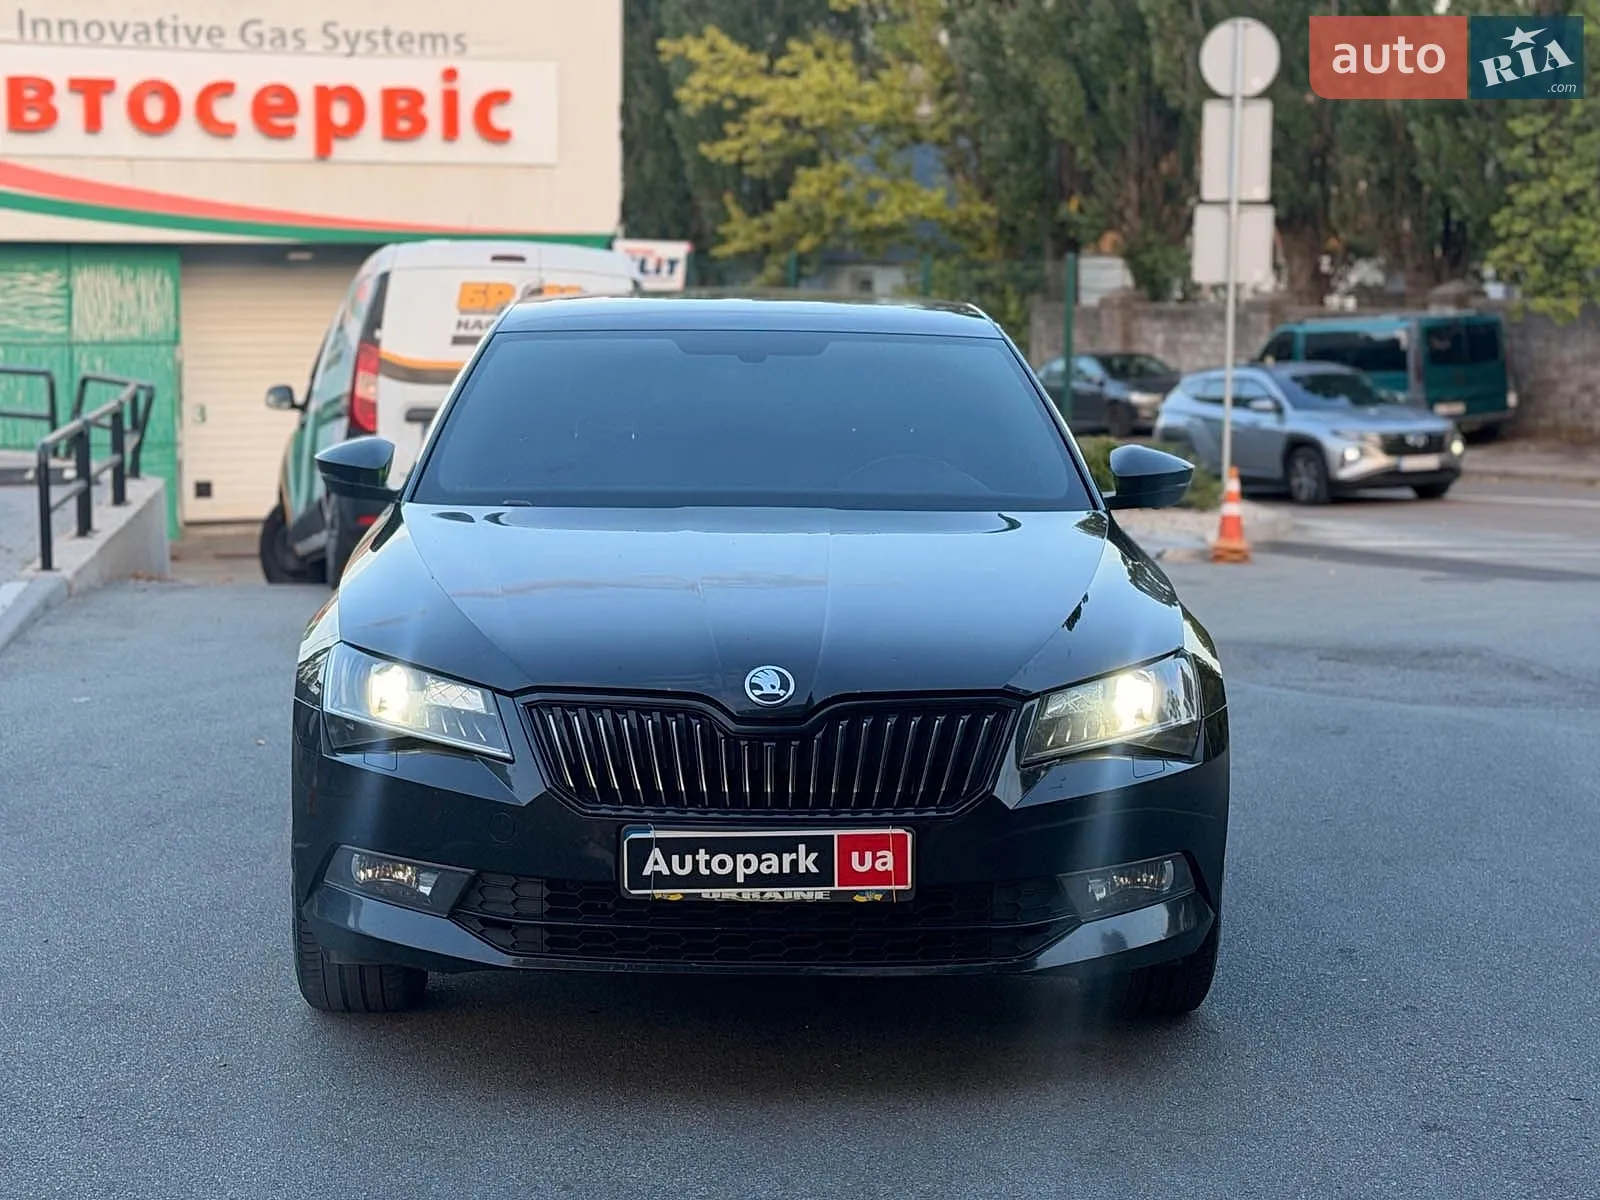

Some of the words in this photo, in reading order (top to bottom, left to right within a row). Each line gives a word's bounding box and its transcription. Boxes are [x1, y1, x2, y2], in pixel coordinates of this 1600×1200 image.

[17, 8, 226, 47] Innovative
[239, 18, 307, 50] Gas
[321, 20, 469, 57] Systems
[642, 844, 820, 883] Autopark
[851, 849, 894, 873] ua
